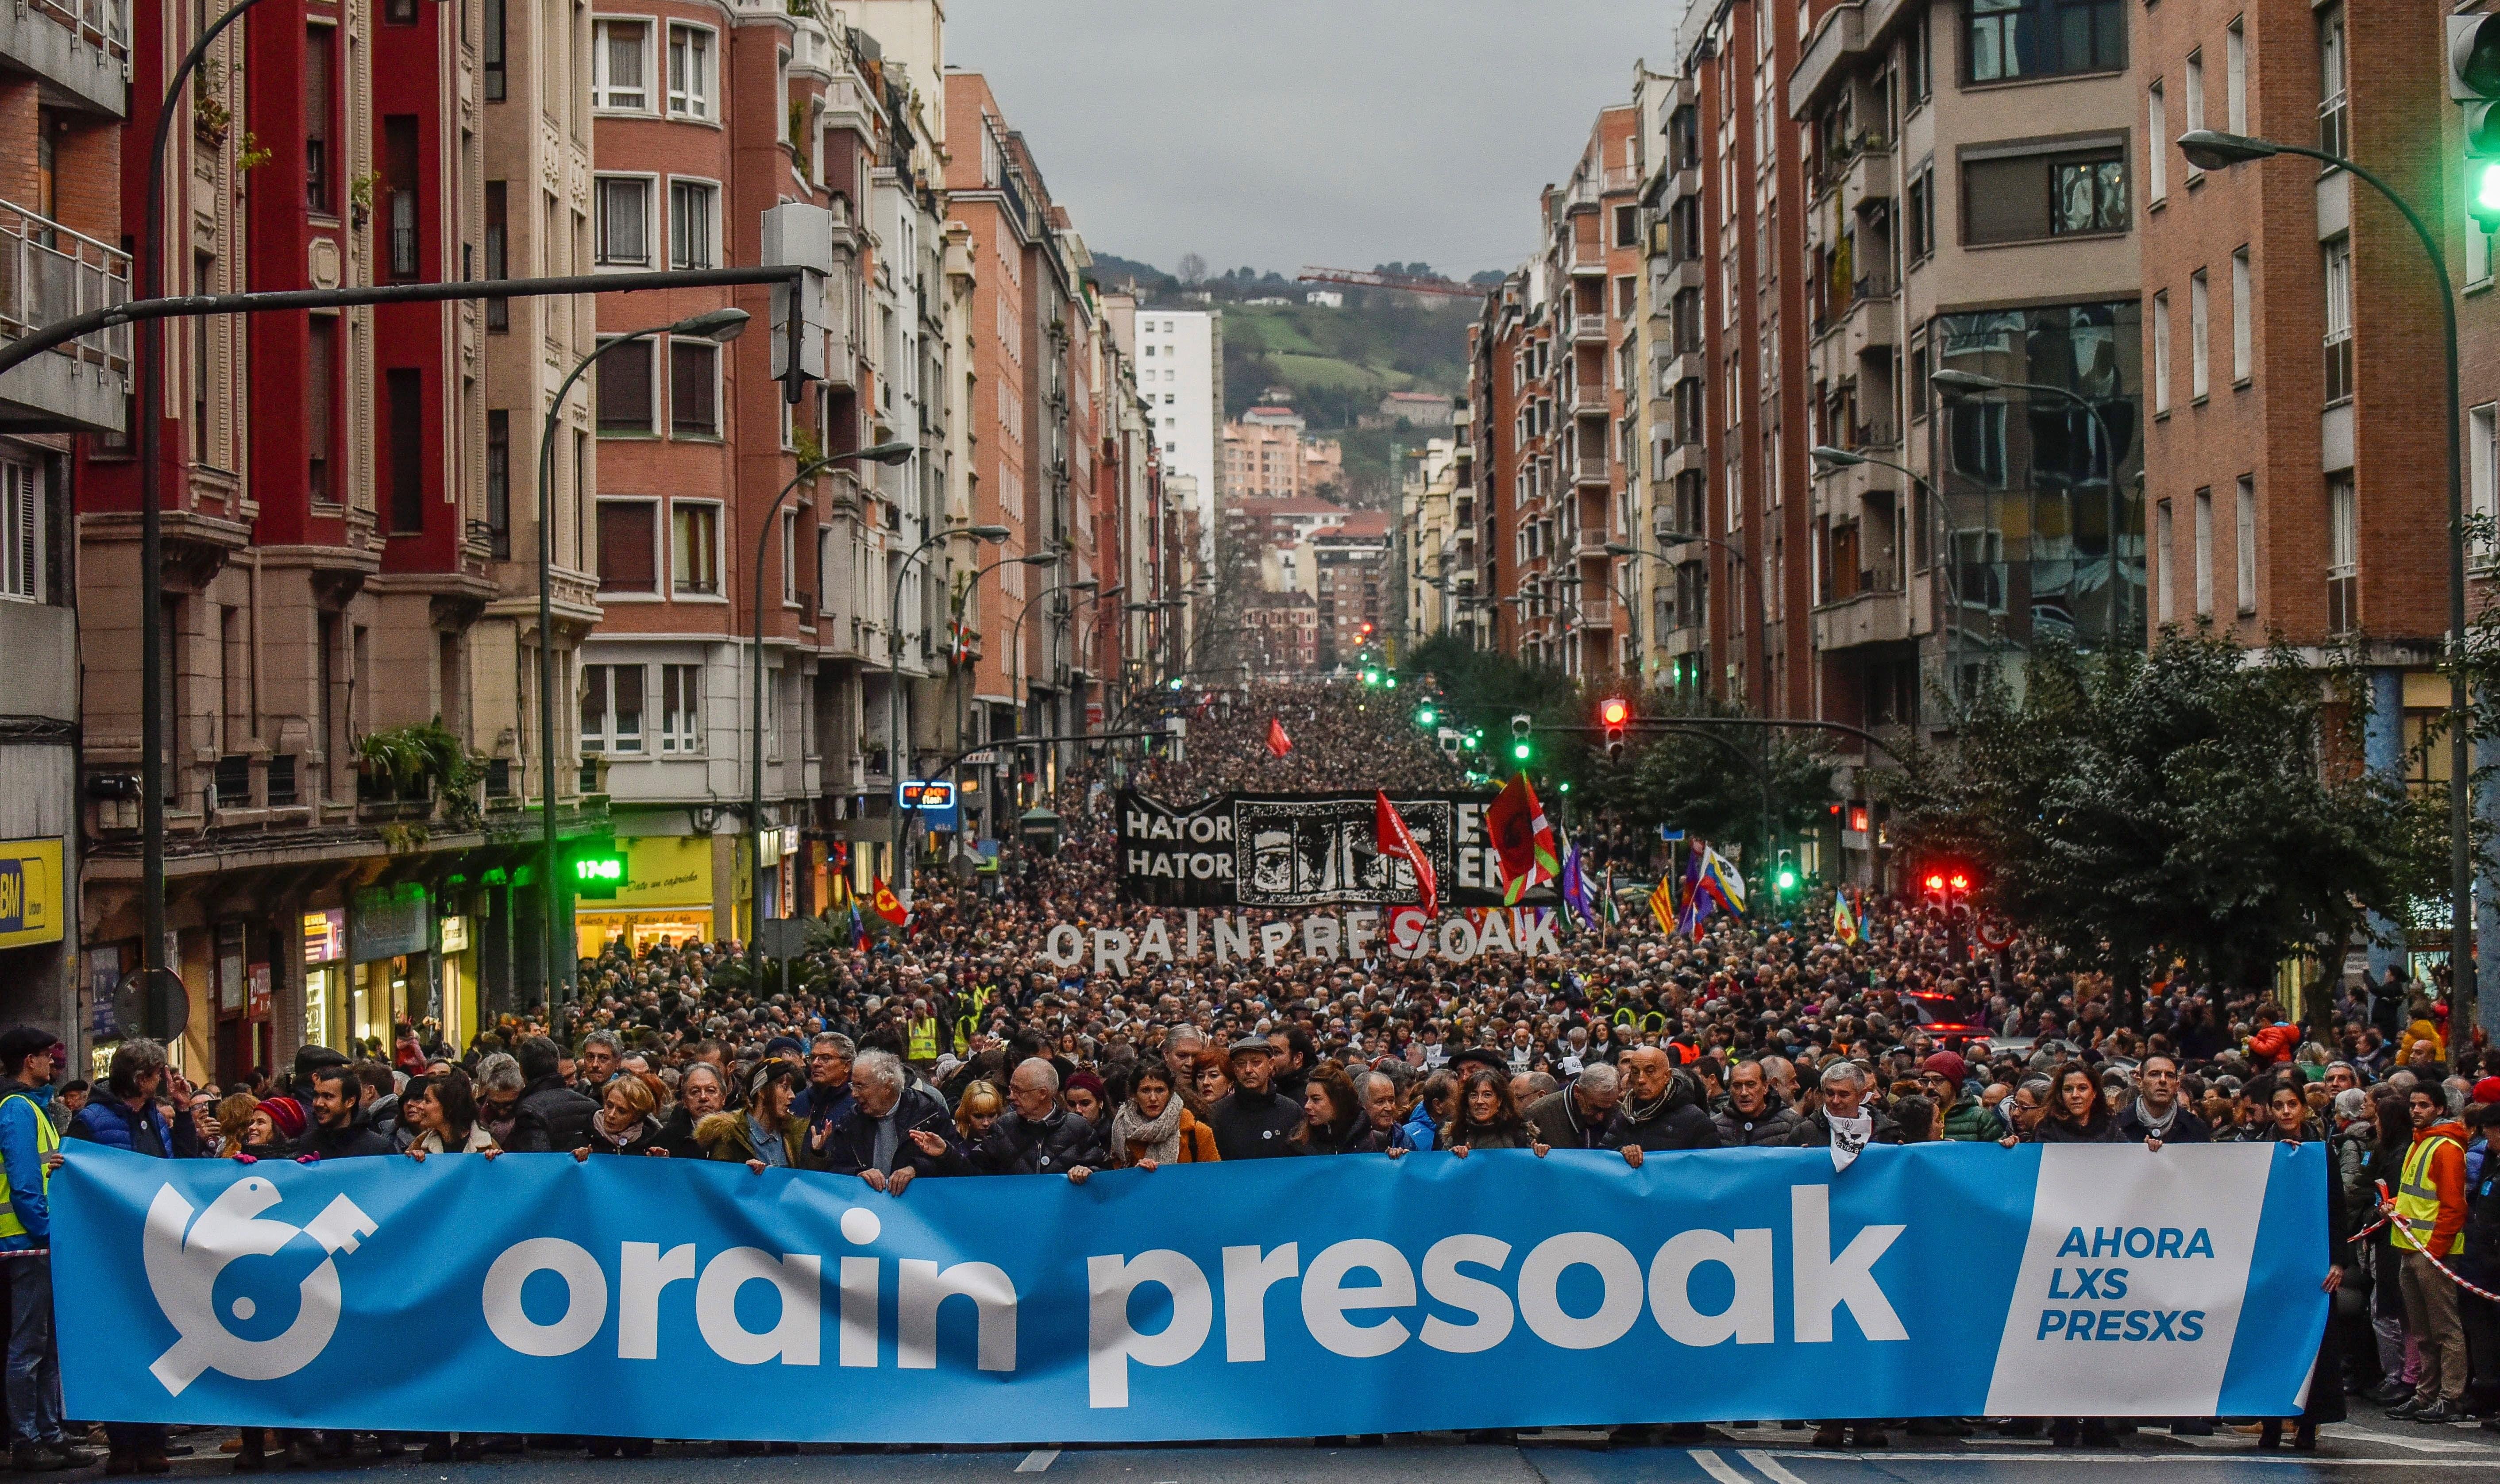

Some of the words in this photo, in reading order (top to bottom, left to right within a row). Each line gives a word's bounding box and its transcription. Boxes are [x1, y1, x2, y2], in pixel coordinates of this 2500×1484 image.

[1127, 811, 1234, 843] HATOR
[1127, 849, 1235, 880] HATOR
[627, 880, 648, 892] Date
[664, 871, 698, 887] capricho
[608, 915, 619, 924] los
[625, 914, 639, 924] 365
[664, 913, 675, 922] del
[2055, 1226, 2215, 1258] AHORA
[482, 1207, 1017, 1371] orain
[1086, 1184, 1910, 1409] presoak
[2047, 1268, 2129, 1299] LXS
[2036, 1309, 2206, 1342] PRESXS
